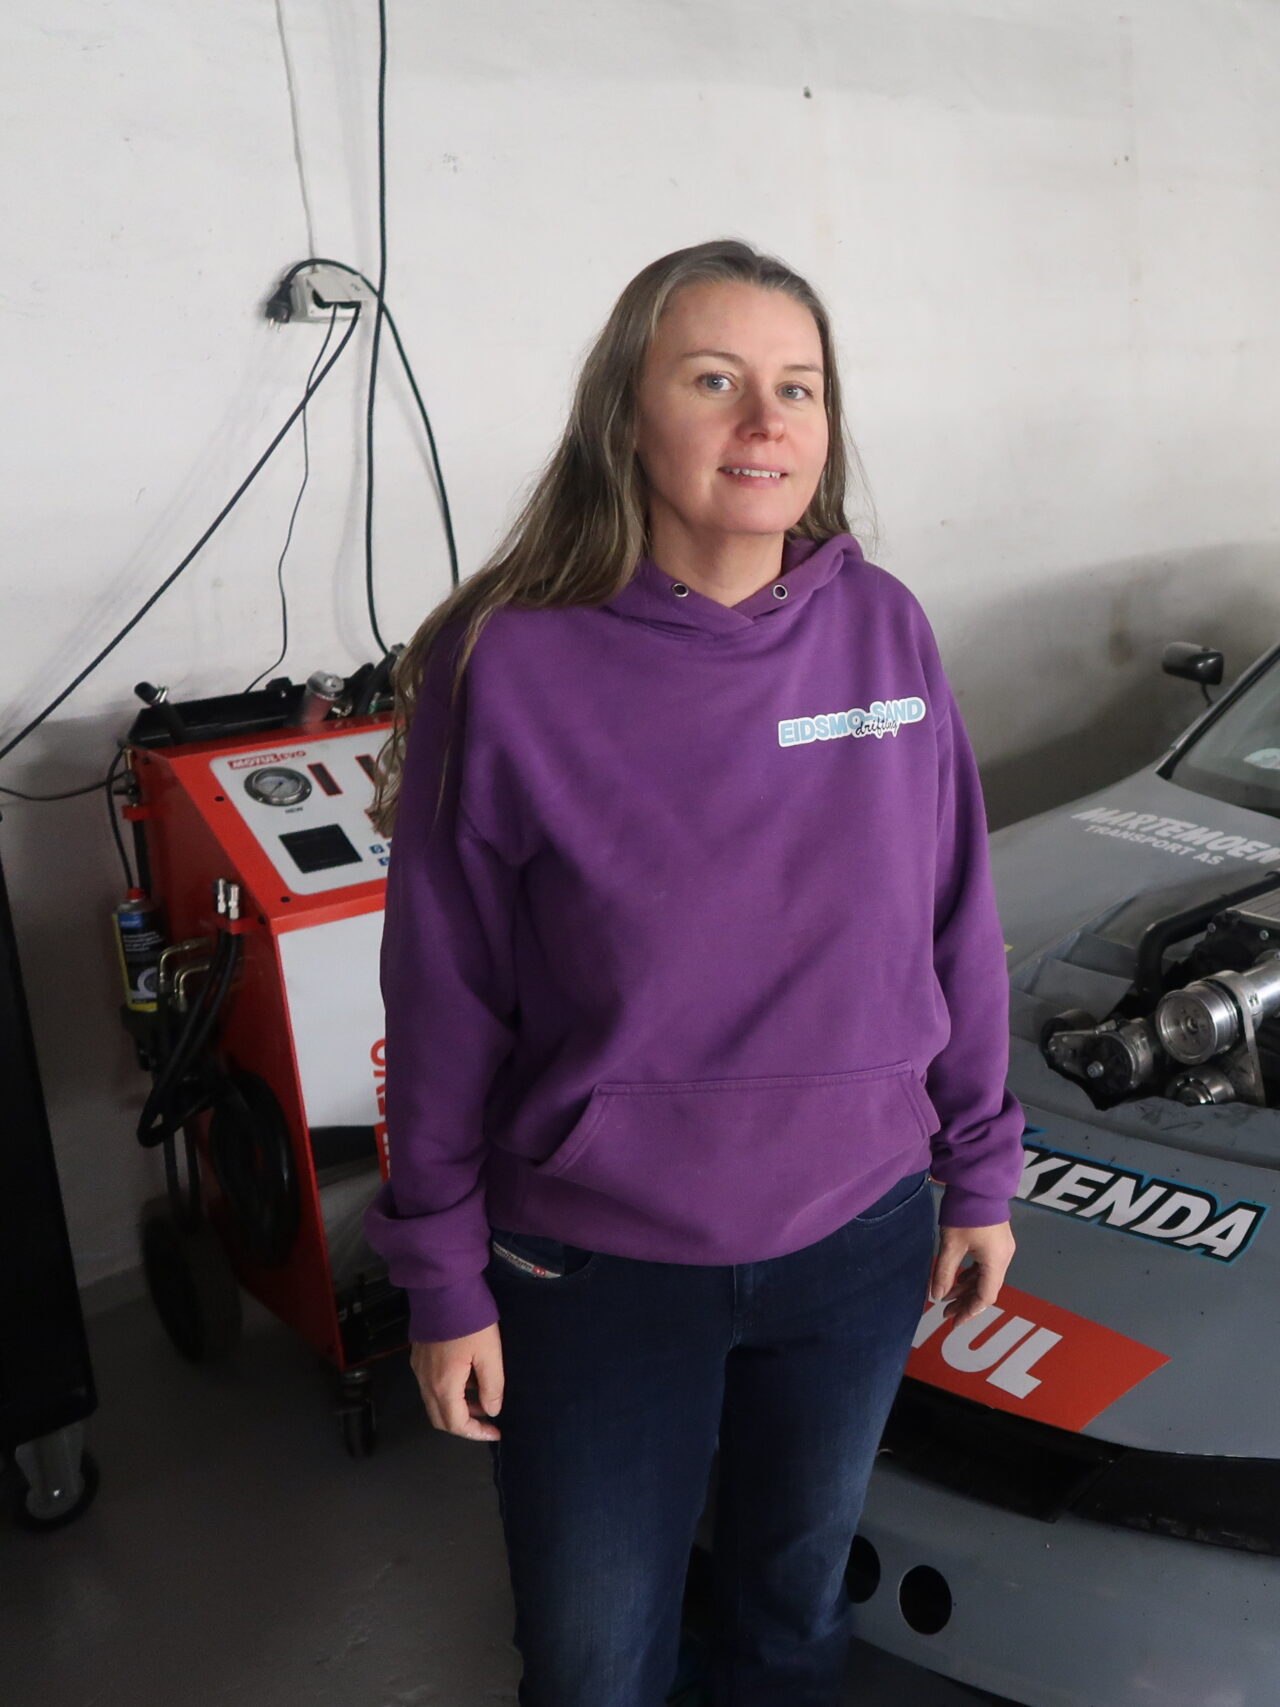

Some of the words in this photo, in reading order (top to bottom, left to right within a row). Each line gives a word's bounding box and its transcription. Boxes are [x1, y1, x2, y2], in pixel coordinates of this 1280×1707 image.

[779, 699, 924, 744] EIDSMO-SAND
[855, 716, 898, 737] drifting
[1084, 825, 1196, 856] TRANSPORT
[1193, 851, 1224, 865] AS
[1015, 1149, 1257, 1258] KENDA
